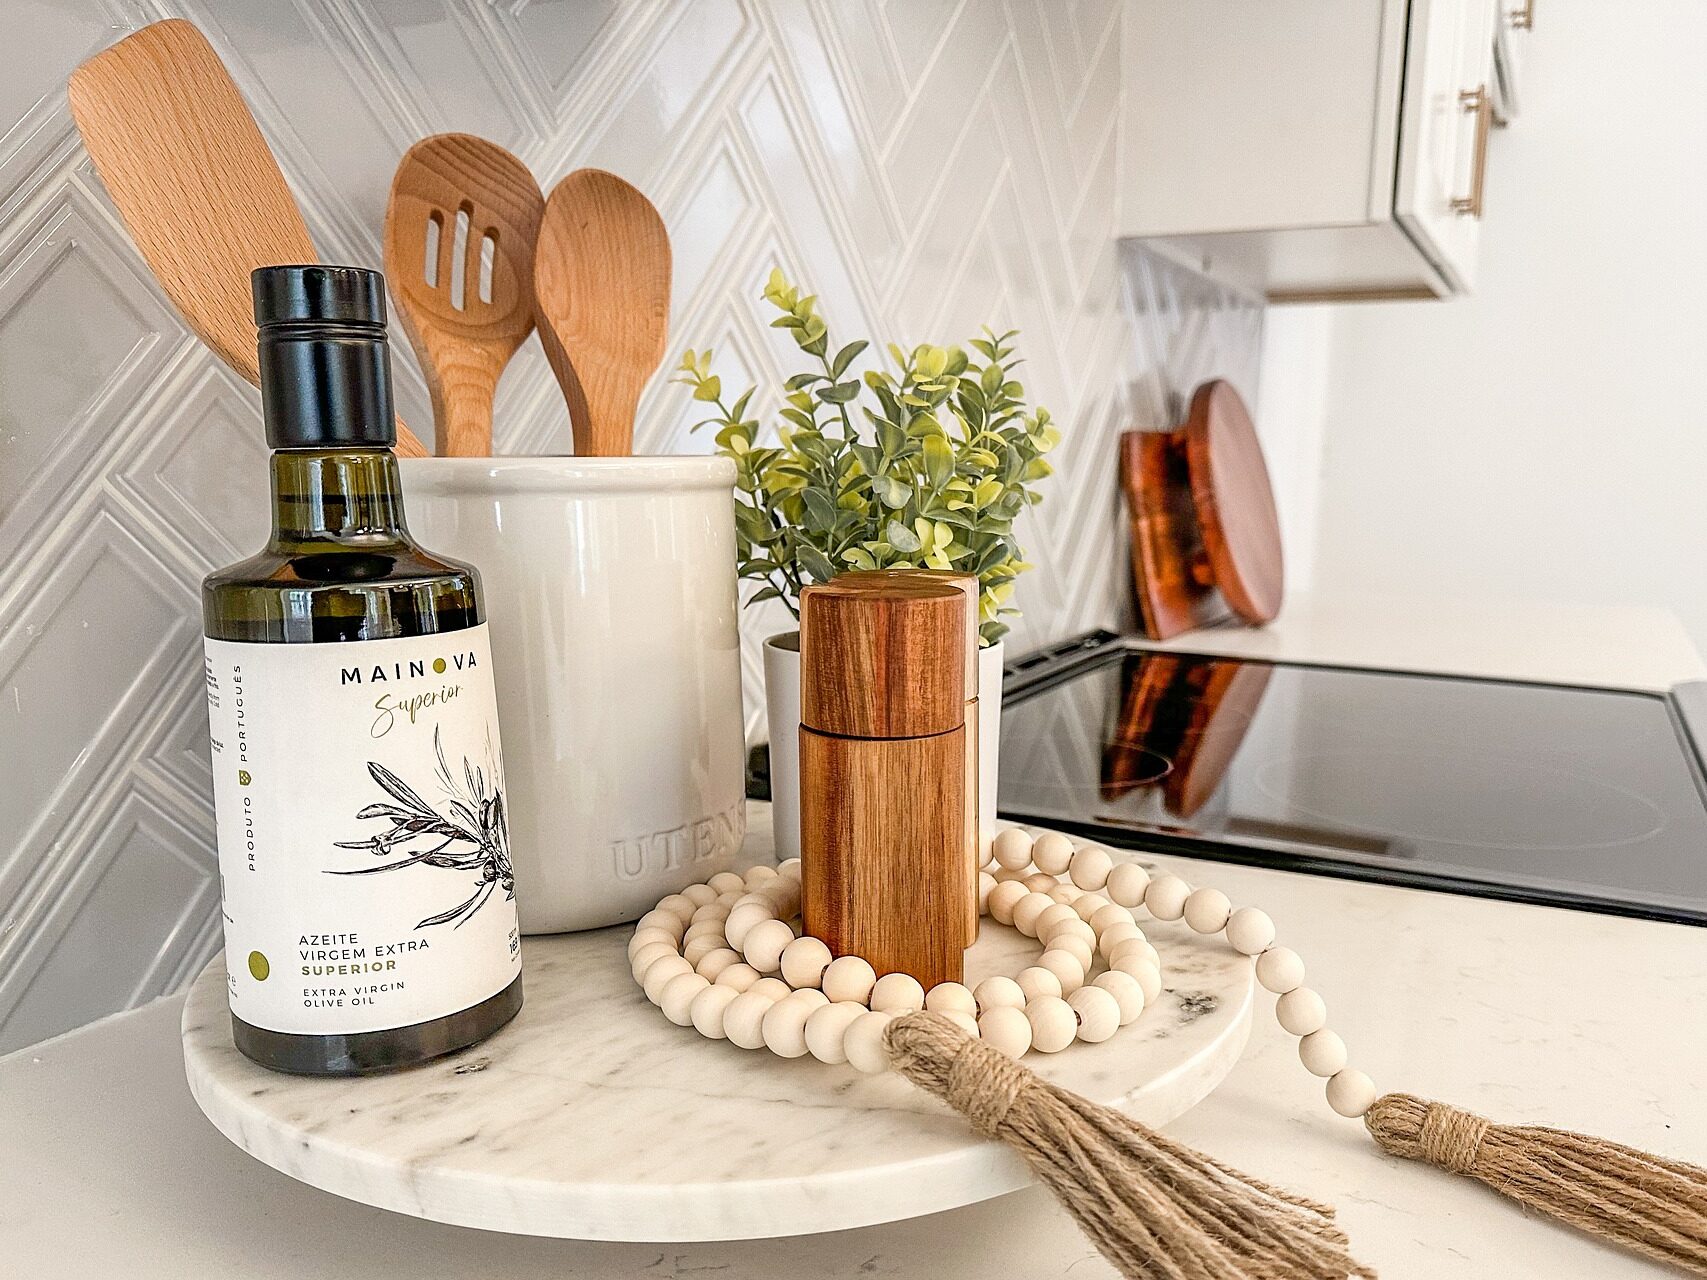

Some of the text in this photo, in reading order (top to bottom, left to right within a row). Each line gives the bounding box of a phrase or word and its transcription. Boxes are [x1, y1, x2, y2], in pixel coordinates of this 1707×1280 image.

[341, 651, 477, 685] MAINOVA
[370, 684, 464, 739] Superior
[232, 665, 256, 871] PRODUTO PORTUGUÊS
[299, 933, 358, 945] AZEITE
[299, 938, 429, 961] VIRGEM EXTRA
[301, 960, 396, 976] SUPERIOR
[303, 981, 405, 997] EXTRA VIRGIN
[303, 996, 375, 1008] OLIVE OIL
